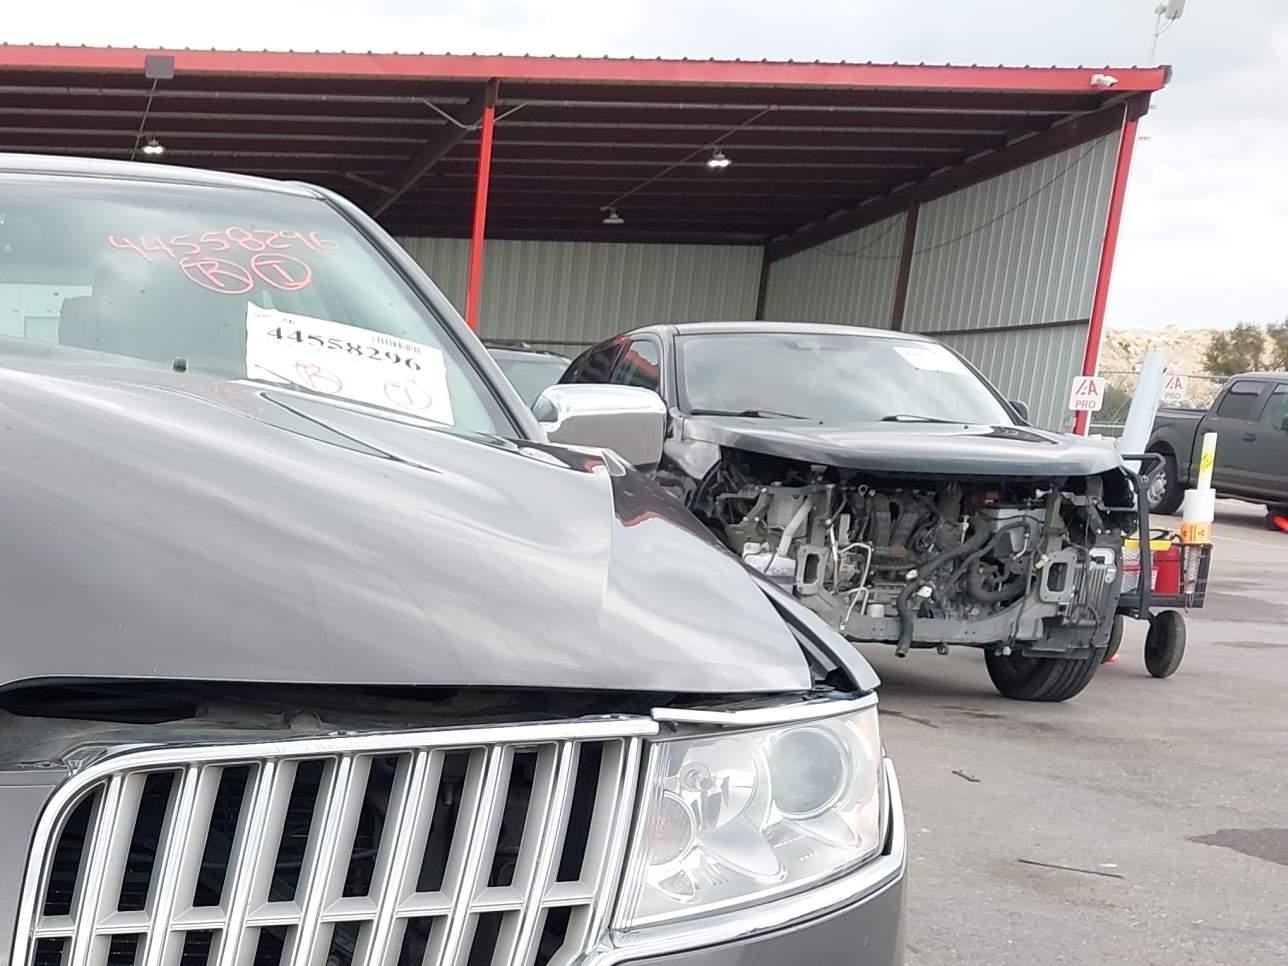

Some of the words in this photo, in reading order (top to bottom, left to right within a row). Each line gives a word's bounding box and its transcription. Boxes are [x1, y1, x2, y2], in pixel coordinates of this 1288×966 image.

[108, 226, 339, 262] 44558296
[1164, 392, 1182, 400] PRO
[1075, 400, 1096, 409] PRO
